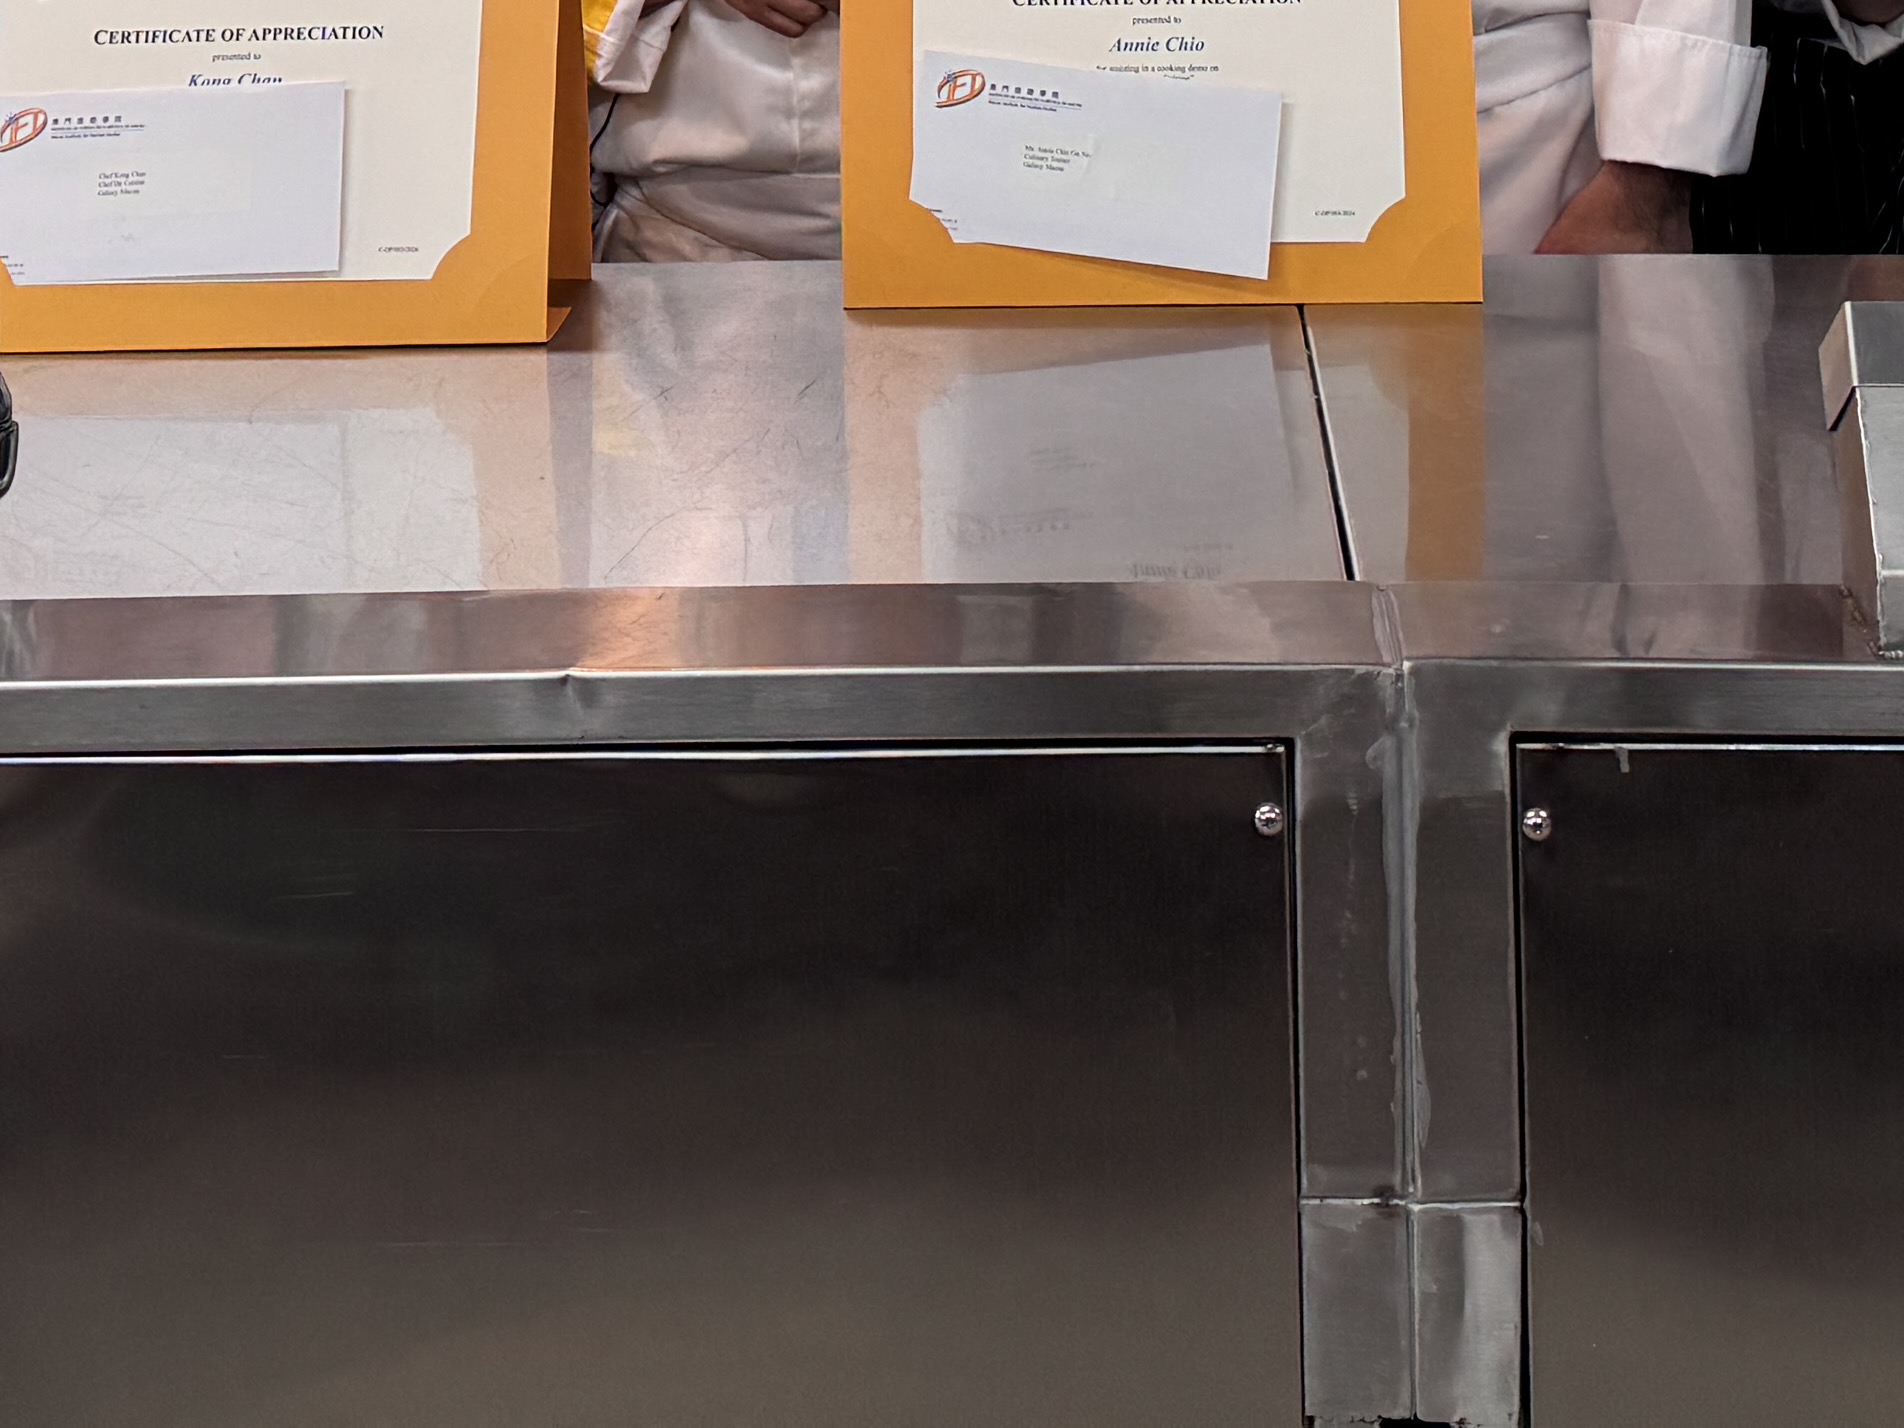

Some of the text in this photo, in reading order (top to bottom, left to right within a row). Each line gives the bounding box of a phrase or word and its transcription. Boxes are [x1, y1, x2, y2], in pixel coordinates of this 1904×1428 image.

[1132, 15, 1182, 26] presented to
[93, 25, 385, 46] CERTIFICATE OF APPRECIATION
[1108, 36, 1206, 53] Annie Chio
[211, 51, 262, 63] presented to
